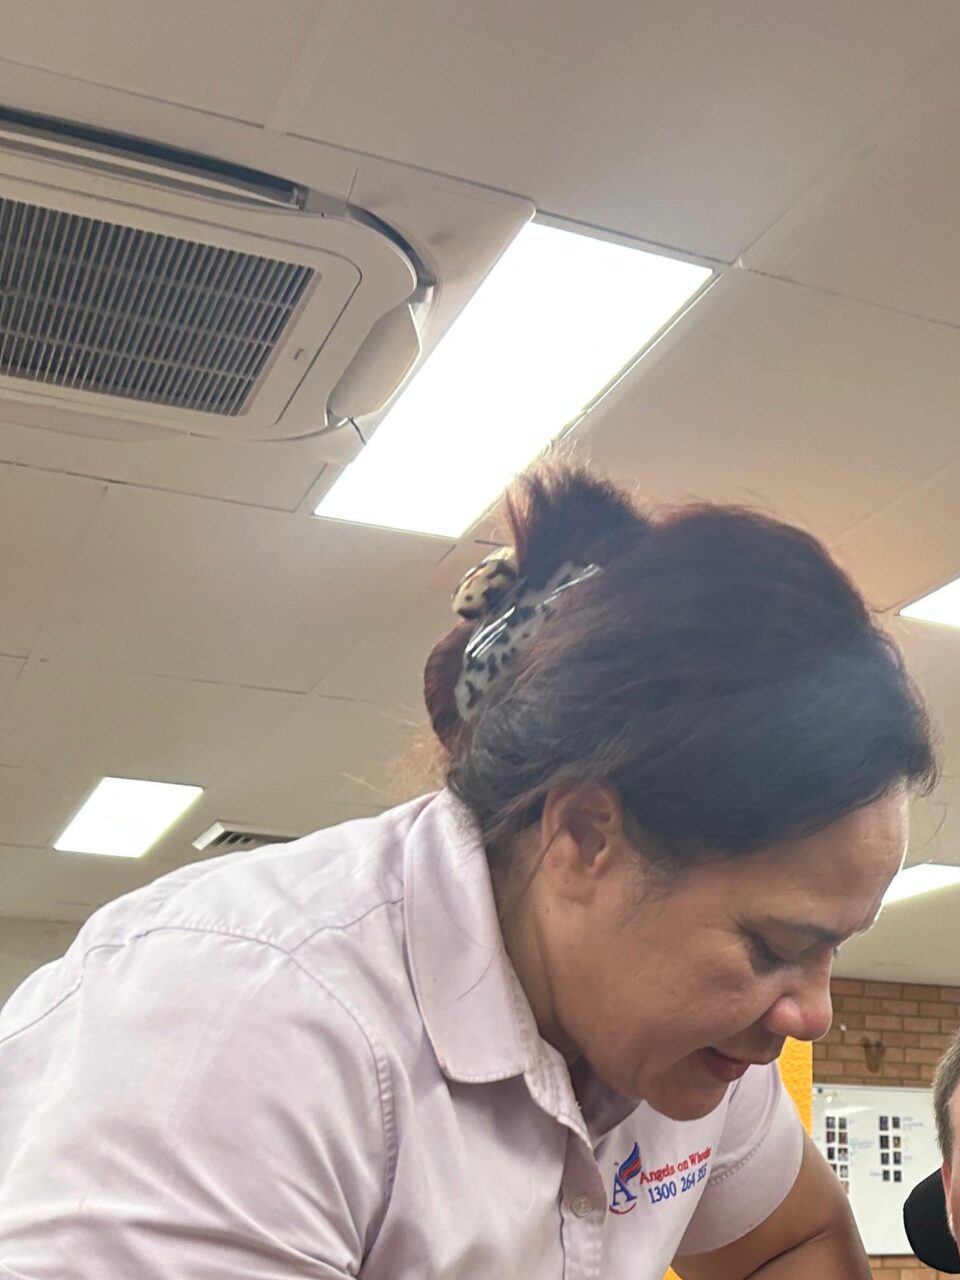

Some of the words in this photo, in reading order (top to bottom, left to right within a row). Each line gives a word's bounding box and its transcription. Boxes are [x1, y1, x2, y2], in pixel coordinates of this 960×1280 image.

[639, 1163, 676, 1185] Angels
[677, 1160, 689, 1172] on
[648, 1180, 677, 1204] 1300
[681, 1172, 695, 1192] 264
